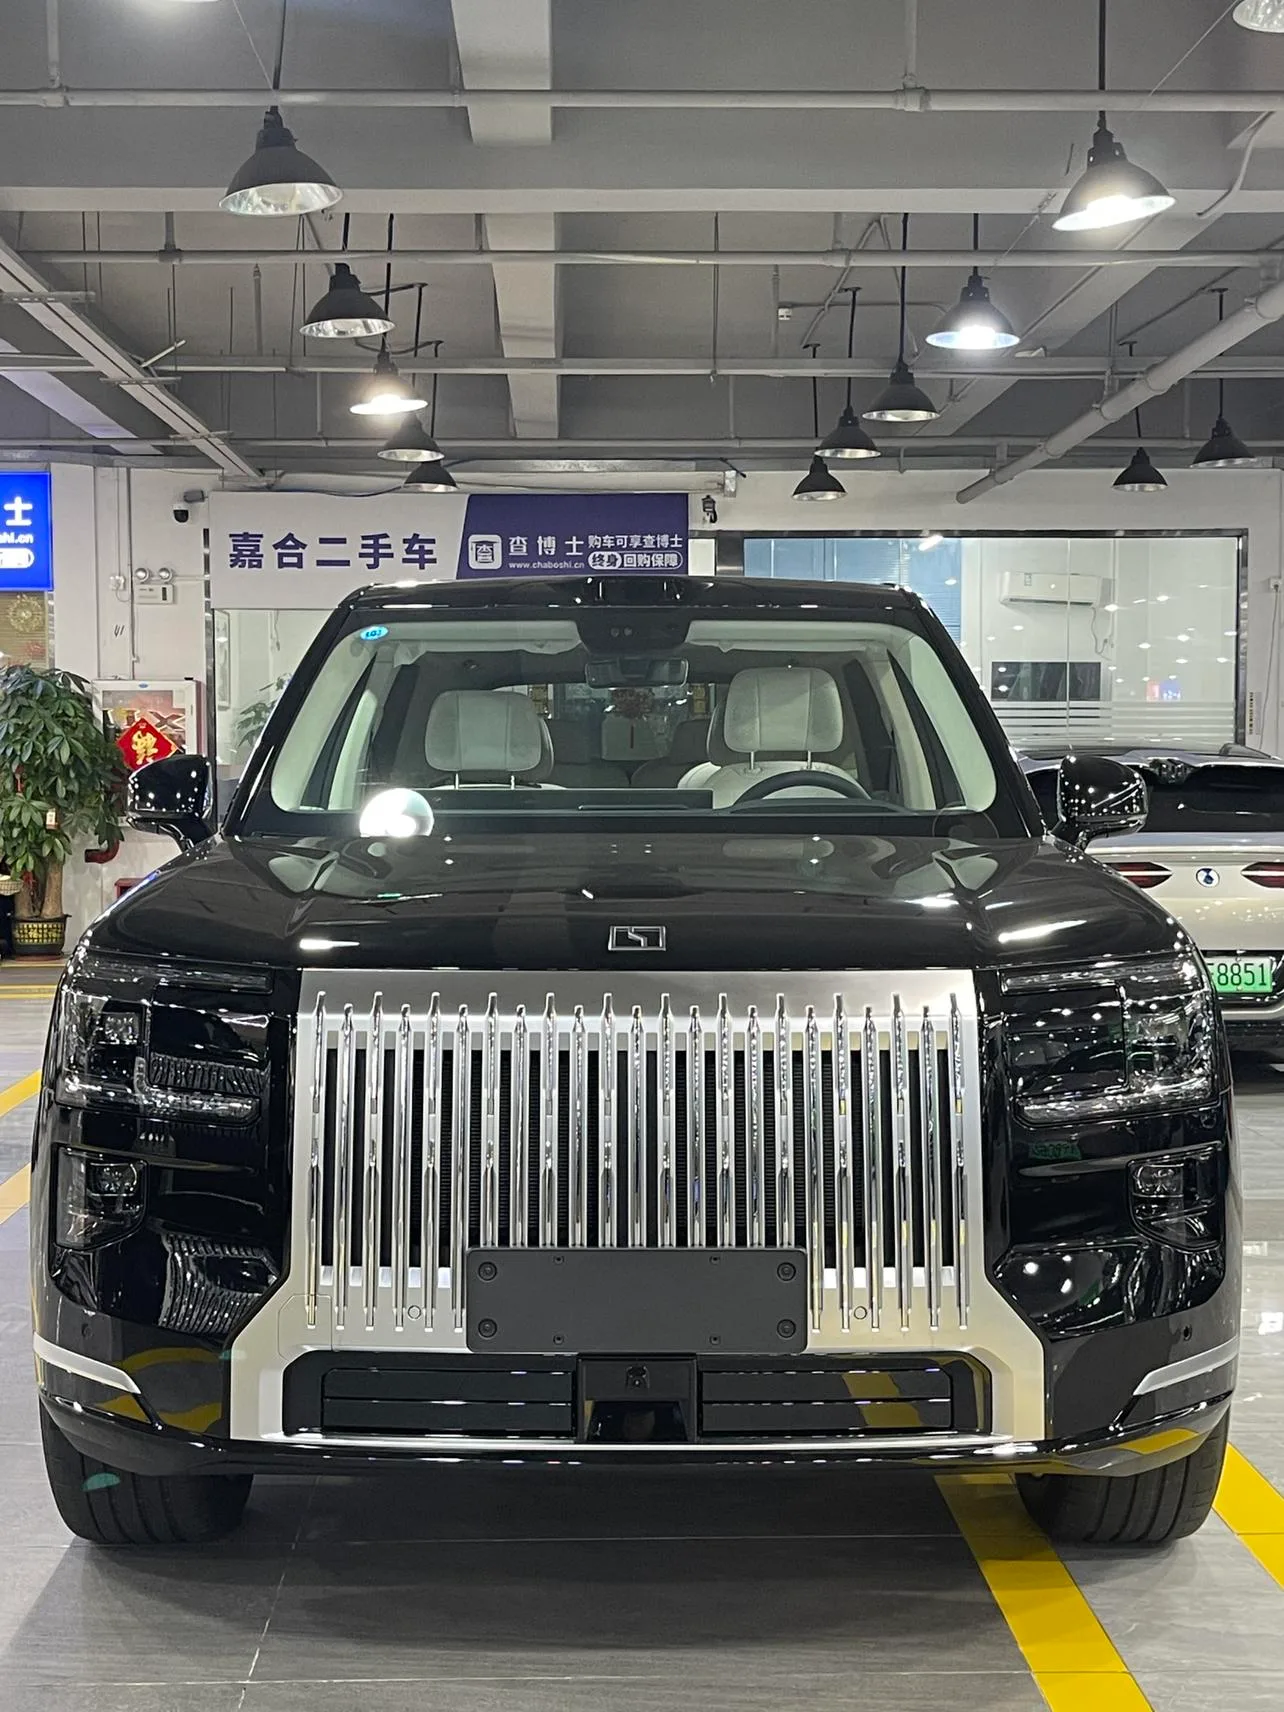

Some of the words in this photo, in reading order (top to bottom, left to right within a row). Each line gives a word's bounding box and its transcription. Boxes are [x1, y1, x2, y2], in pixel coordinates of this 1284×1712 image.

[3, 496, 34, 526] 士
[508, 535, 585, 556] 查博士
[588, 533, 683, 549] 购车可享查博士
[229, 531, 438, 570] 嘉合二手车
[508, 561, 585, 569] www.chaboshi.cn
[592, 552, 618, 568] 终身
[623, 552, 679, 568] 回购保障
